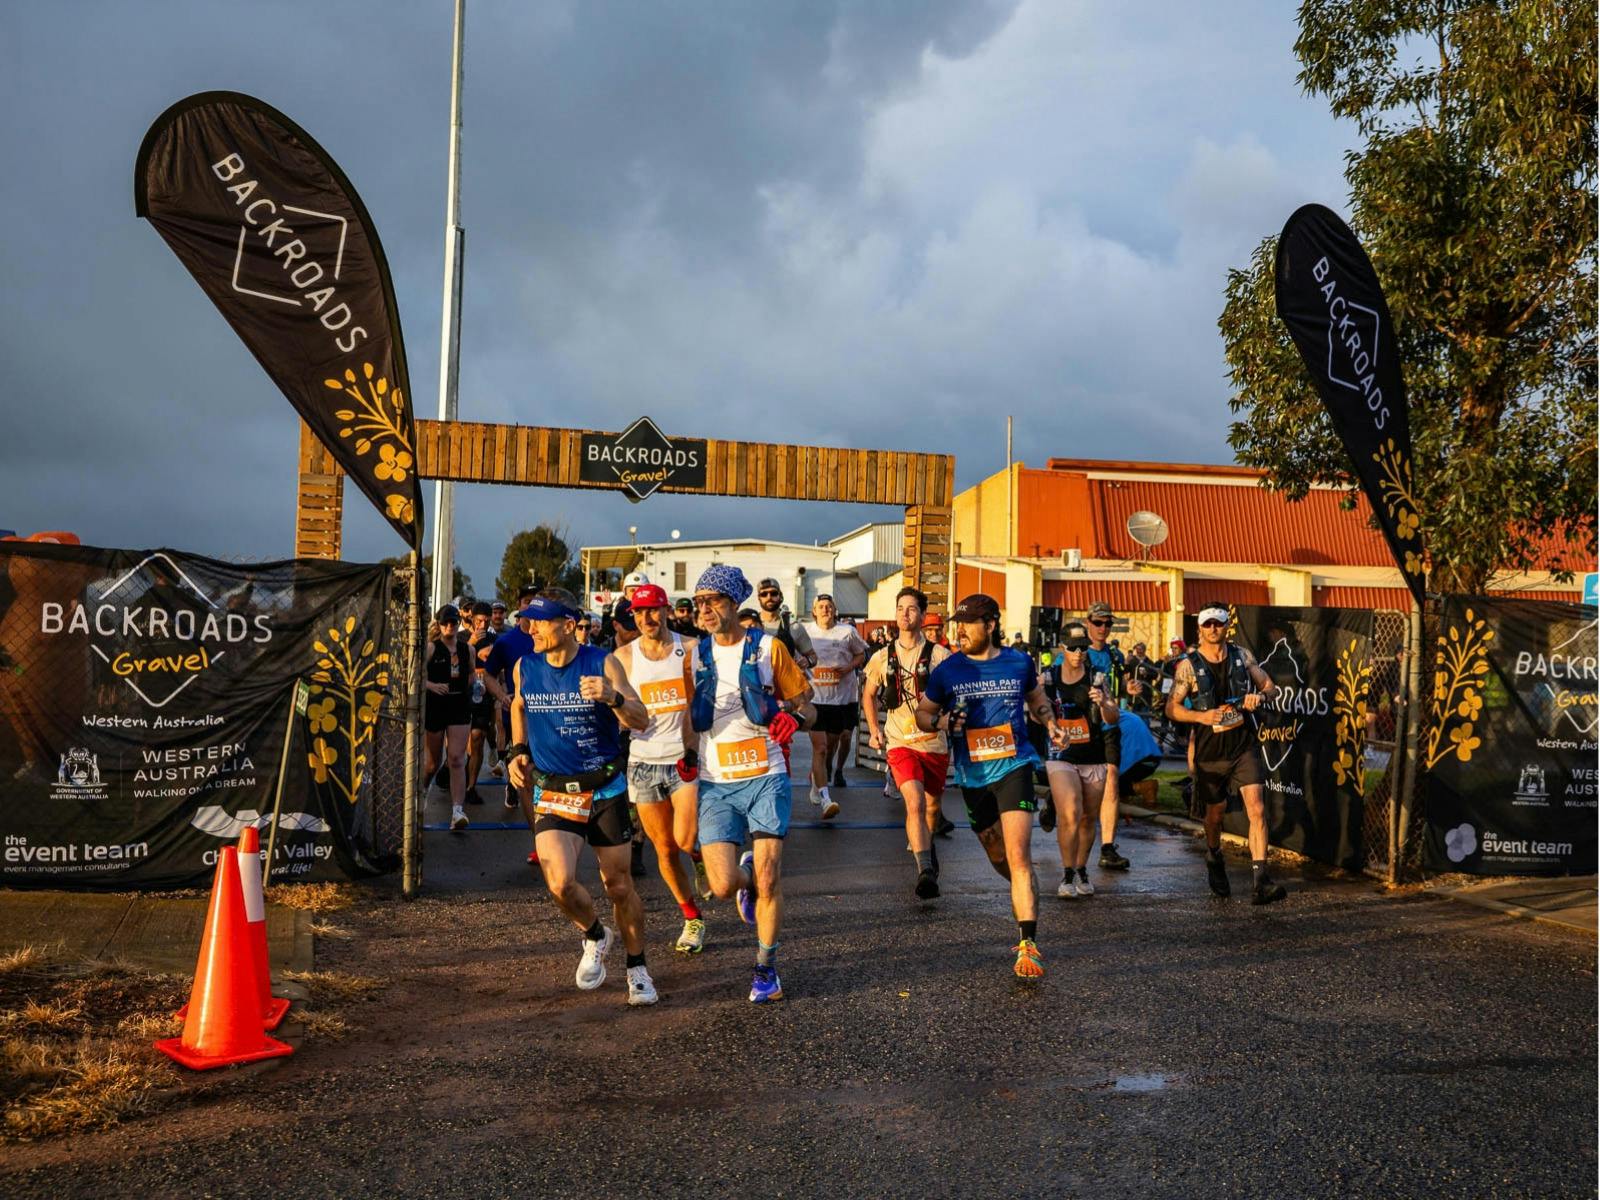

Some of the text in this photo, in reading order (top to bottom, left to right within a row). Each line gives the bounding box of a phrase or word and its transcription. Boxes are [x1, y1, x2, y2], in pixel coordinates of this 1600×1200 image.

[211, 151, 368, 354] BACKROADS
[1312, 255, 1391, 430] BACKROADS
[587, 444, 699, 468] BACKROADS
[620, 467, 668, 483] Gravel
[41, 602, 273, 643] BACKROADS
[111, 646, 210, 676] Gravel
[1514, 651, 1597, 681] BACKR
[649, 687, 679, 702] 1163
[82, 714, 226, 730] Western Australia
[1257, 718, 1298, 742] Gravel
[975, 735, 1006, 749] 1129
[1536, 738, 1578, 750] Western
[142, 742, 247, 764] WESTERN
[727, 749, 758, 765] 1113
[133, 756, 255, 782] AUSTRALIA
[133, 785, 187, 798] WALKING
[214, 777, 257, 789] DREAM
[5, 834, 28, 846] the
[1482, 839, 1573, 855] event team
[4, 841, 149, 862] event team
[283, 843, 334, 860] Valley
[28, 864, 83, 874] management
[84, 862, 130, 872] consultants
